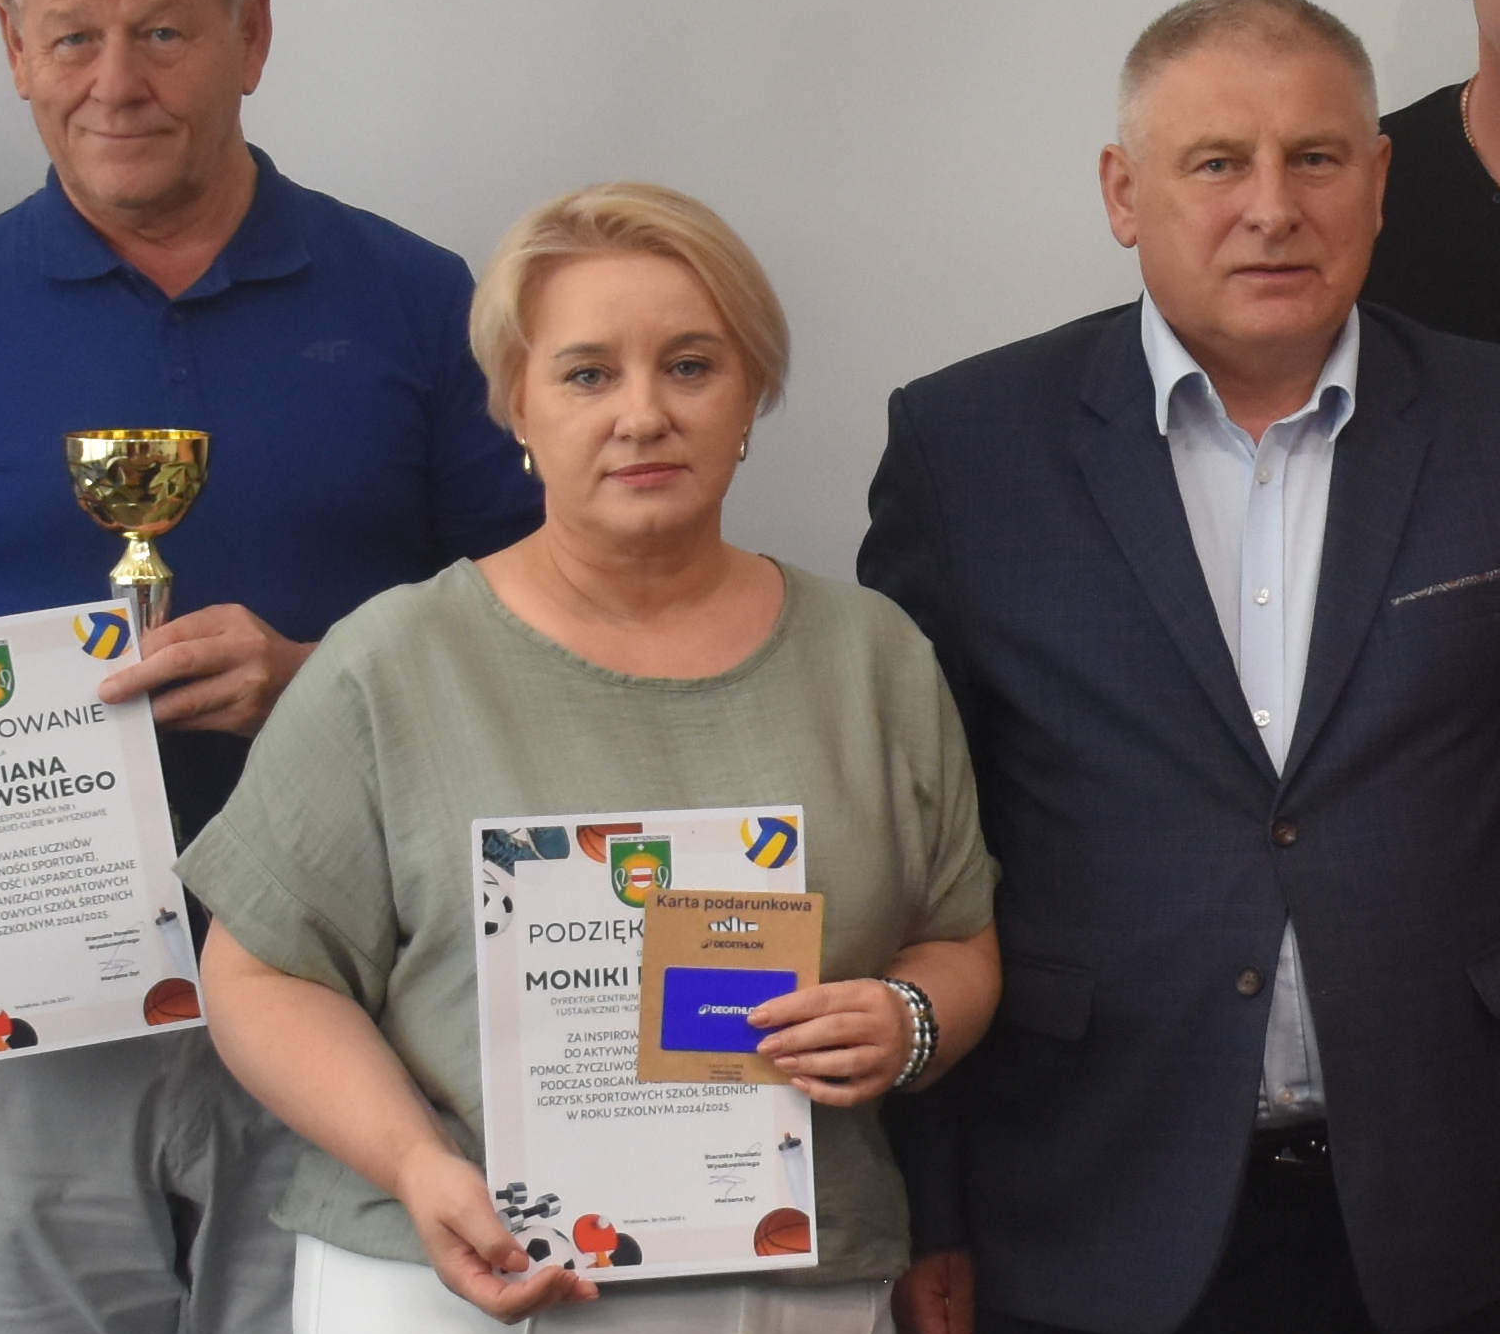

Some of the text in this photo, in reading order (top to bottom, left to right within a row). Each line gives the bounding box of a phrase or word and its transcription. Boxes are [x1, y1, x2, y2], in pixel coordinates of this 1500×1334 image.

[39, 837, 92, 855] UCZNIÓW
[28, 869, 84, 887] WSPARCIE
[84, 859, 137, 877] OKAZANE
[45, 876, 129, 899] POWIATOWYCH
[43, 896, 78, 914] SZKÓŁ
[78, 889, 134, 908] ŚREDNICH
[657, 894, 812, 912] Karta podarunkowa
[529, 919, 644, 944] PODZIĘK
[714, 940, 764, 950] DECATHLON
[525, 966, 628, 991] MONIKI
[550, 993, 639, 1006] DYREKTOR CENTRUM
[567, 1032, 583, 1043] ZA
[564, 1048, 581, 1058] DO
[540, 1079, 593, 1091] PODCZAS
[537, 1084, 758, 1106] IGRZYSK SPORTOWYCH SZKÓŁ ŚREDNICH
[566, 1110, 580, 1120] W
[581, 1108, 612, 1120] ROKU
[614, 1104, 675, 1118] SZKOLNYM
